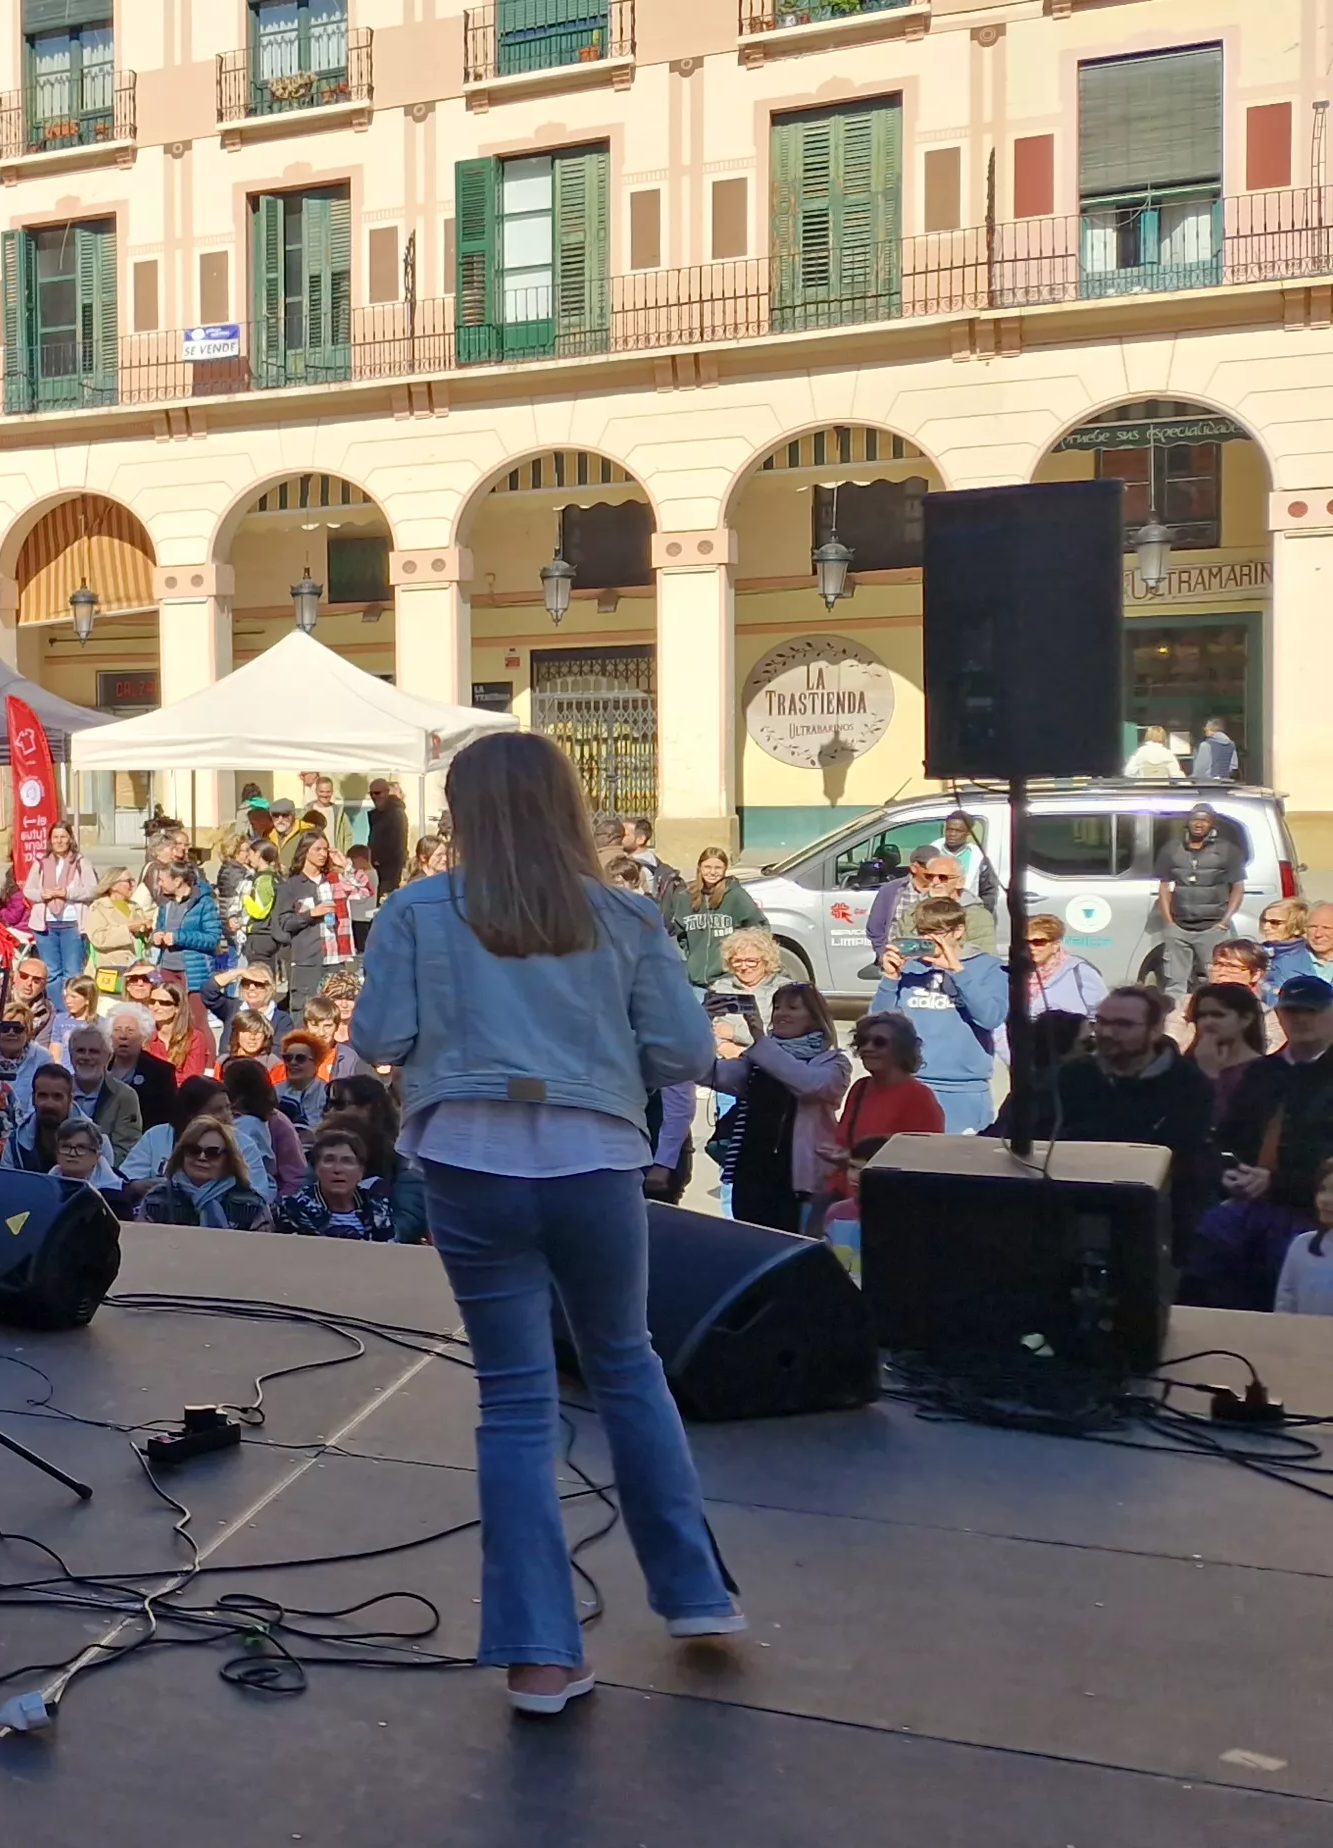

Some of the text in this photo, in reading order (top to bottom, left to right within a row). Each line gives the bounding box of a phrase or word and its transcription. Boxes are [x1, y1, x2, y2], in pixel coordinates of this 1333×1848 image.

[184, 342, 236, 356] SE VENDE
[1116, 429, 1140, 441] sus
[806, 664, 825, 690] LA
[765, 690, 867, 716] TRASTIENDA
